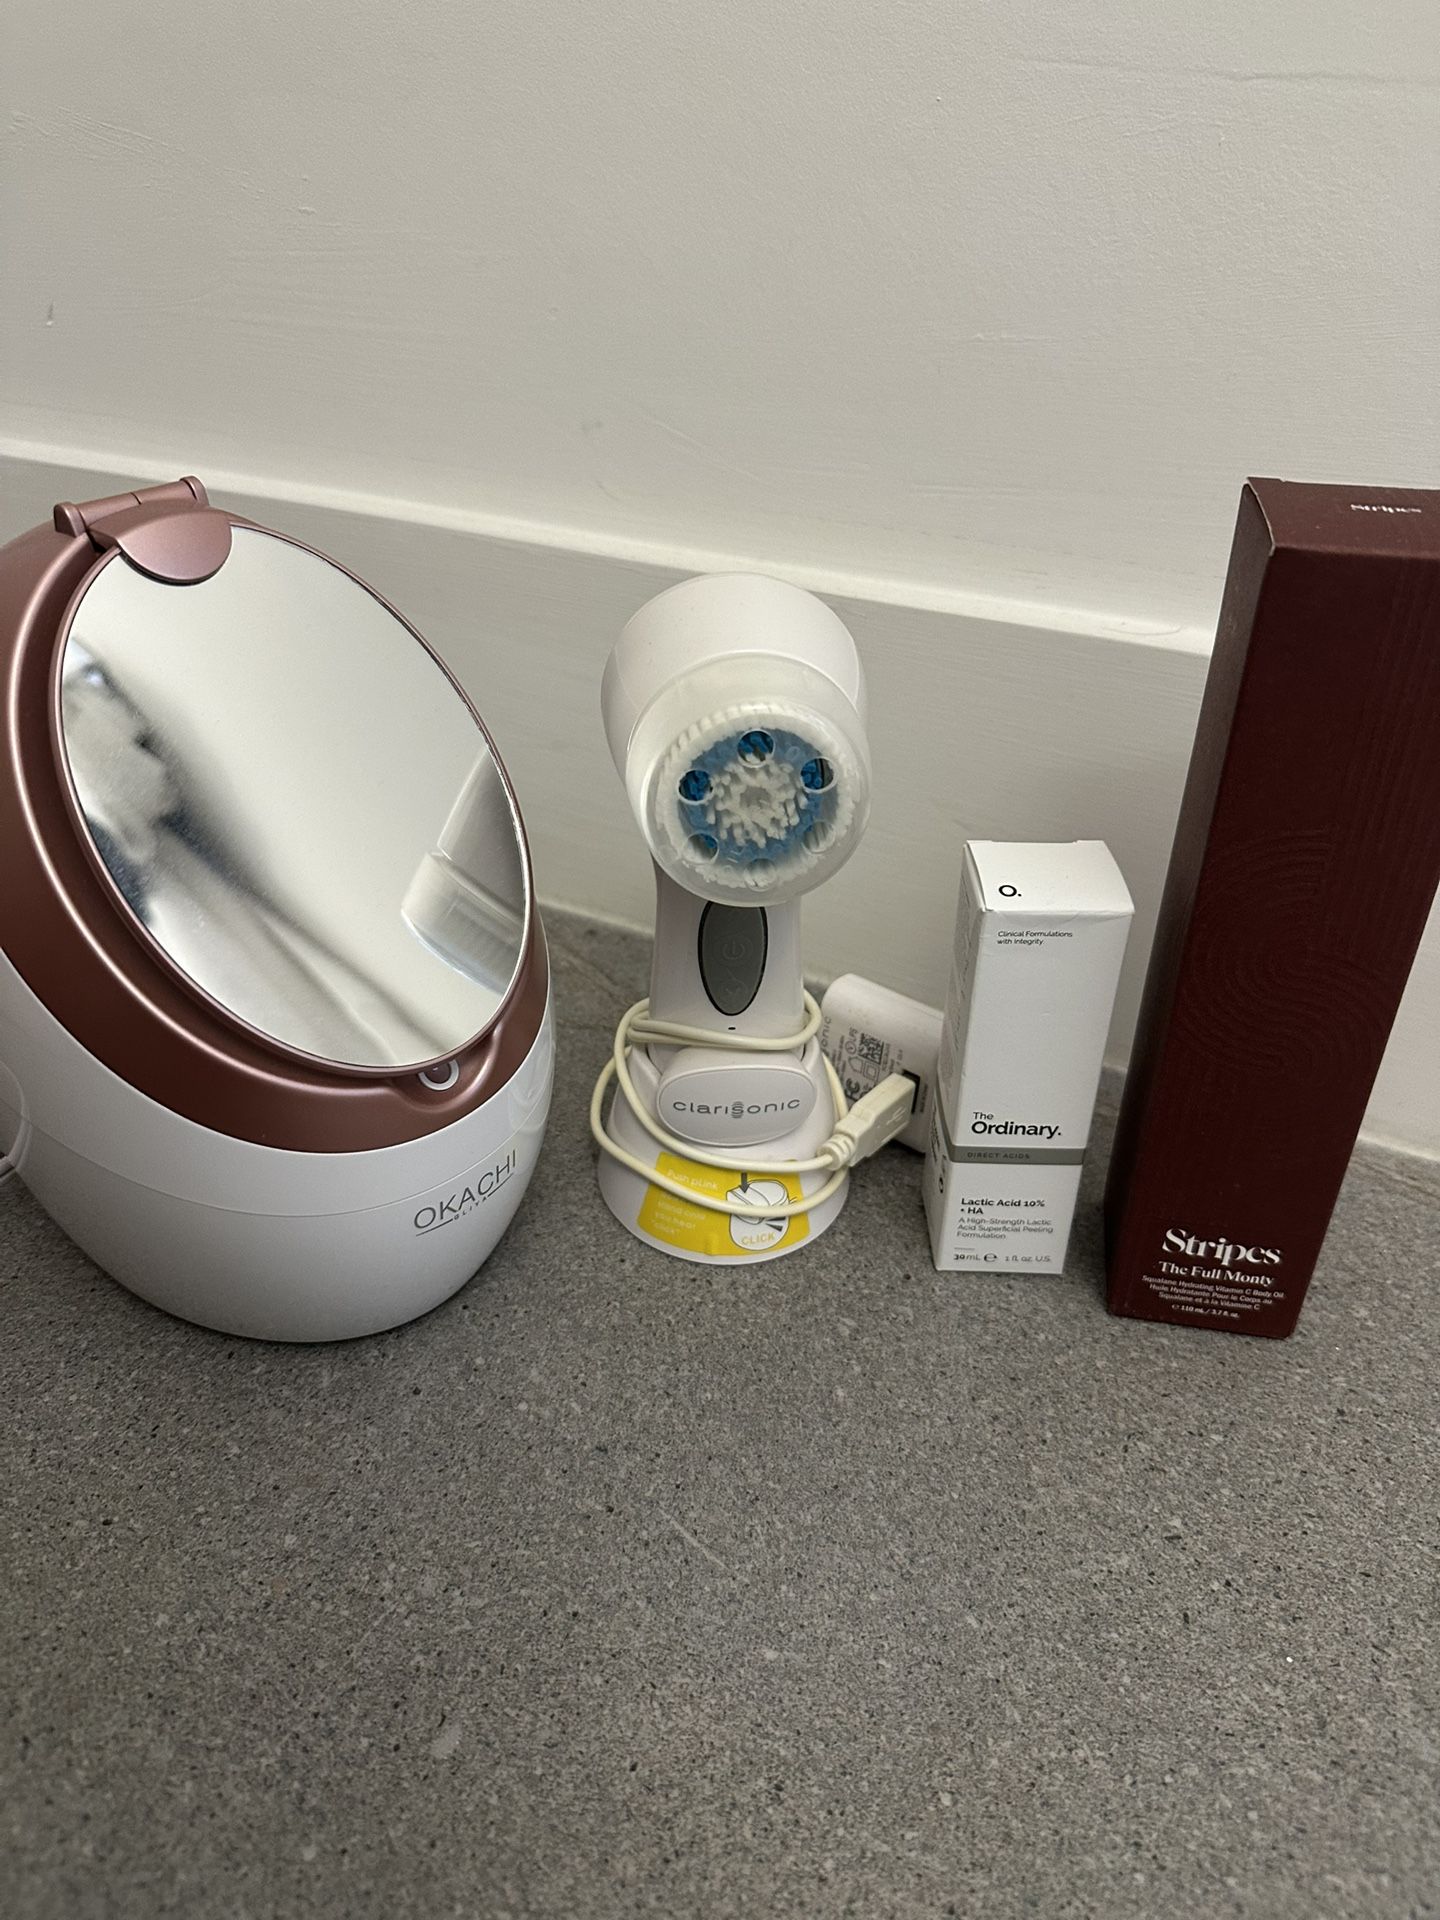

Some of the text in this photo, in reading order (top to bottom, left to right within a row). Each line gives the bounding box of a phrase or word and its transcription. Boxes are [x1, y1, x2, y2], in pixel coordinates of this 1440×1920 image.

[998, 930, 1073, 938] Clinical Formulations
[672, 1099, 801, 1119] clarisonic
[973, 1111, 994, 1121] The
[971, 1120, 1062, 1140] Ordinary.
[967, 1151, 1030, 1160] DIRECT ACIDS
[414, 1149, 516, 1230] OKACHI
[961, 1198, 1045, 1208] Lactic Acid 10%
[967, 1207, 984, 1215] HA
[966, 1217, 1026, 1226] High-Strength
[1026, 1218, 1052, 1226] Lactic
[956, 1230, 1007, 1240] Formulation
[977, 1224, 1021, 1233] Superficial
[1022, 1225, 1054, 1234] Peeling
[741, 1232, 776, 1246] CLICK
[1161, 1228, 1282, 1267] Stripes
[1158, 1260, 1275, 1287] The Full Monty
[1142, 1275, 1177, 1286] Squalane
[1178, 1280, 1214, 1292] Hydrating
[1215, 1285, 1244, 1295] Vitamin
[1245, 1287, 1252, 1295] C
[1252, 1289, 1271, 1298] Body
[1170, 1286, 1210, 1298] Hydratante
[1158, 1291, 1193, 1303] Squalane
